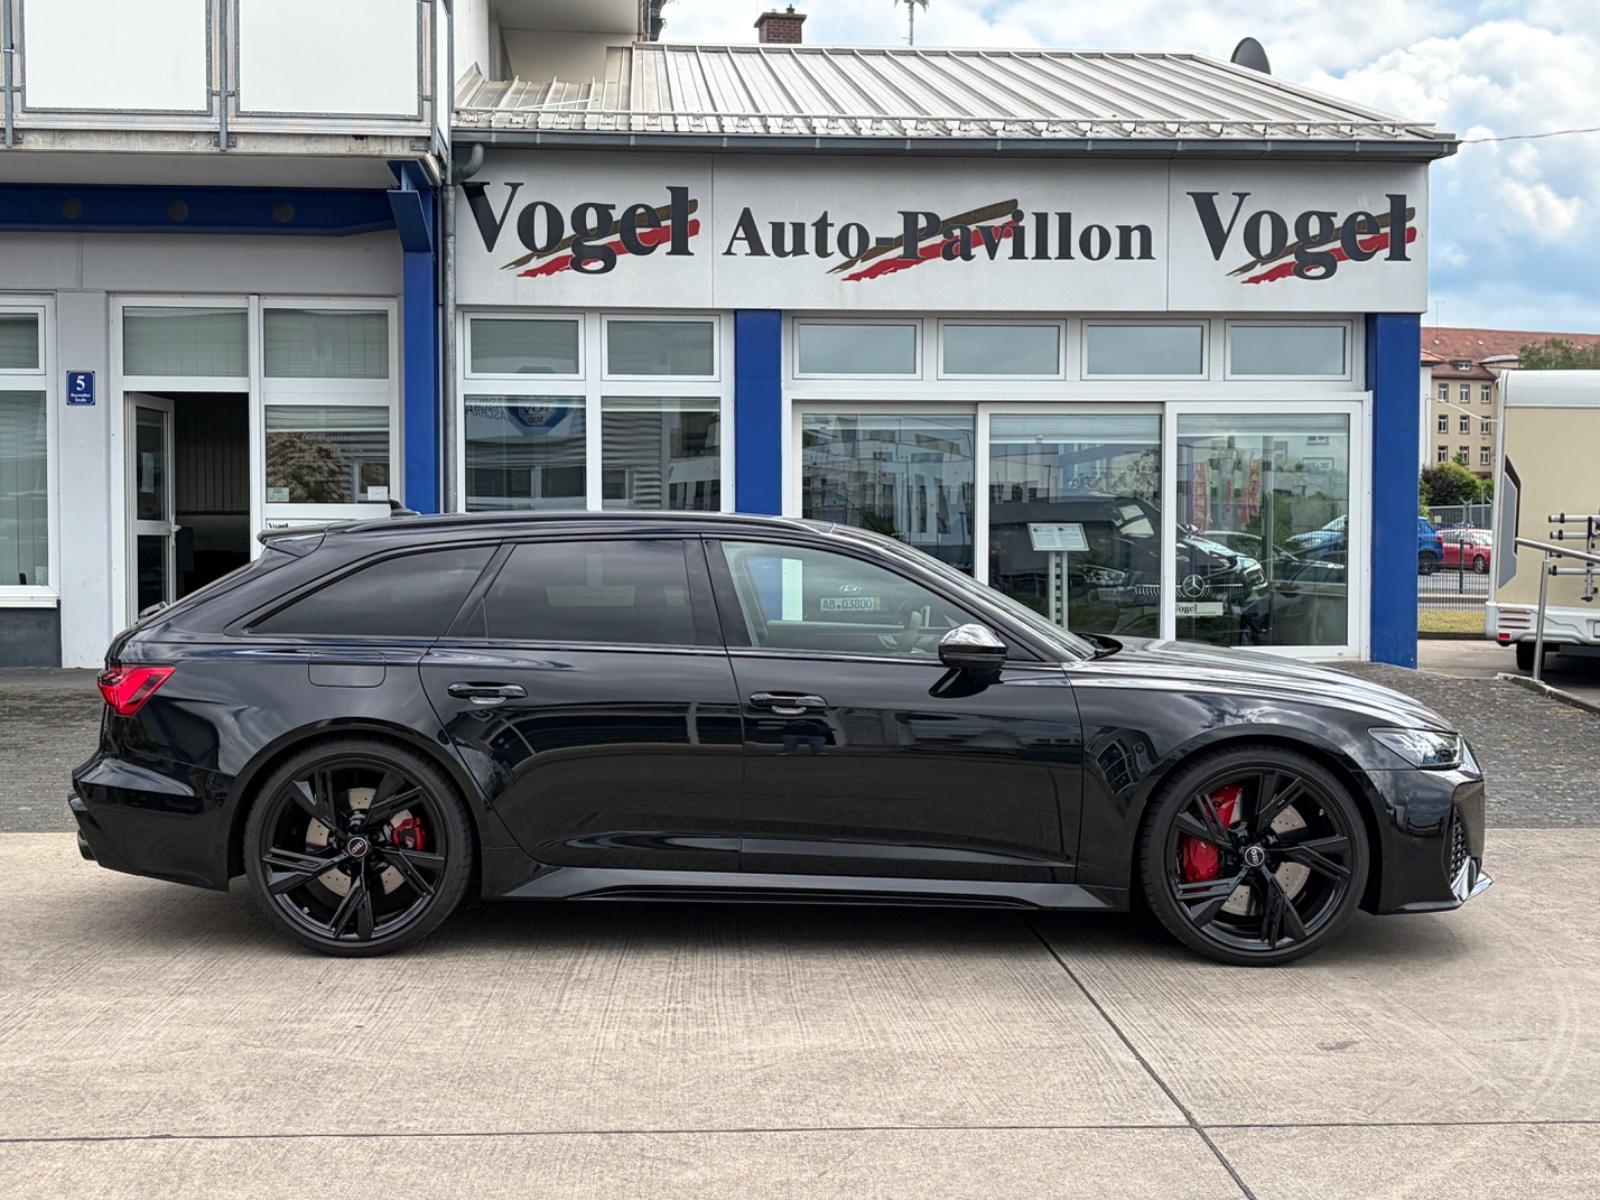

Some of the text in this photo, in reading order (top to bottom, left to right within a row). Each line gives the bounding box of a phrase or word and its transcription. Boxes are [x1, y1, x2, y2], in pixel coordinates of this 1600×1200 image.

[460, 181, 695, 275] Vogel
[722, 206, 1156, 262] Auto-Pavillon
[1186, 191, 1412, 281] Vogel
[76, 375, 85, 391] 5
